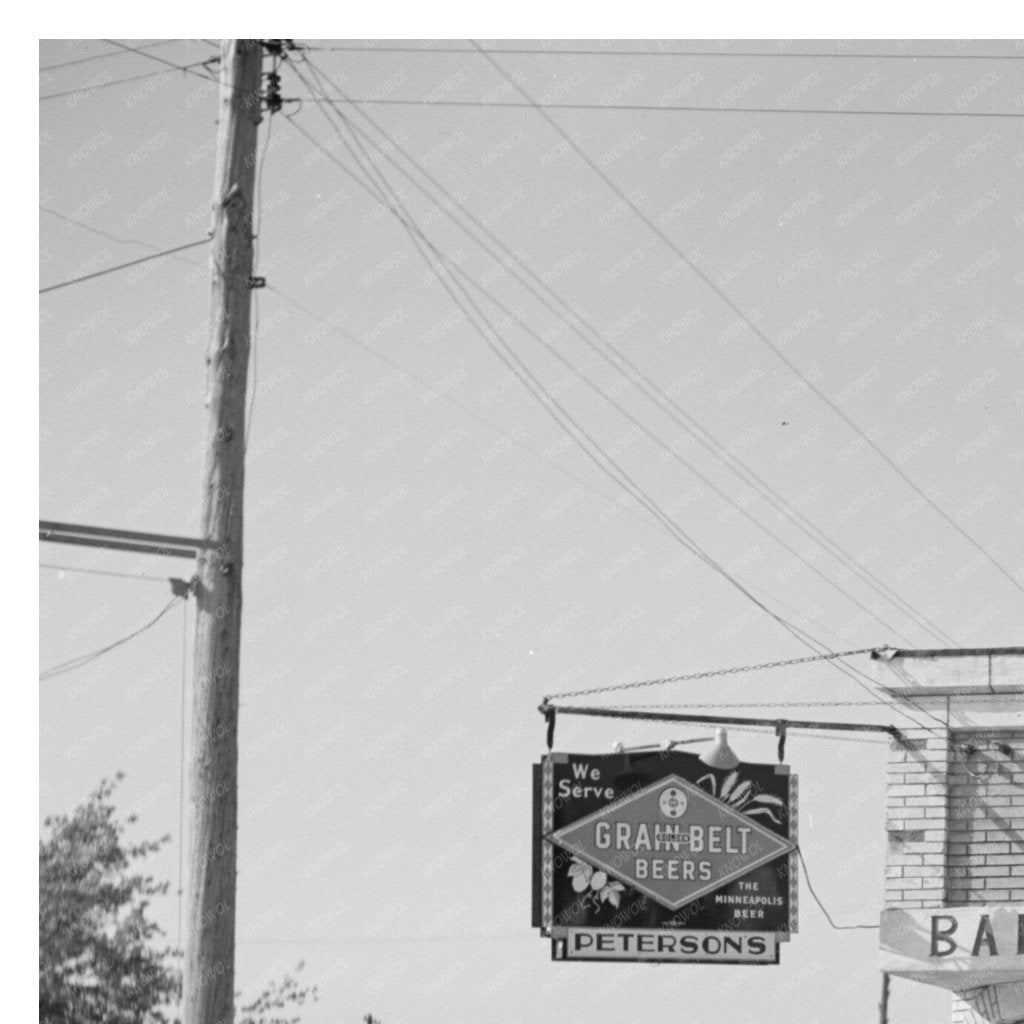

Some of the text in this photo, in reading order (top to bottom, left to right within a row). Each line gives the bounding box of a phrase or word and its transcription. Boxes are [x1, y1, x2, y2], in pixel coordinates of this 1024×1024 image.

[572, 763, 601, 780] We
[558, 780, 615, 799] Serve
[595, 821, 751, 854] GRAIN BELT
[635, 858, 712, 881] BEERS
[738, 881, 759, 891] THE
[715, 894, 783, 906] MINNEAPOLIS
[733, 908, 765, 919] BEER
